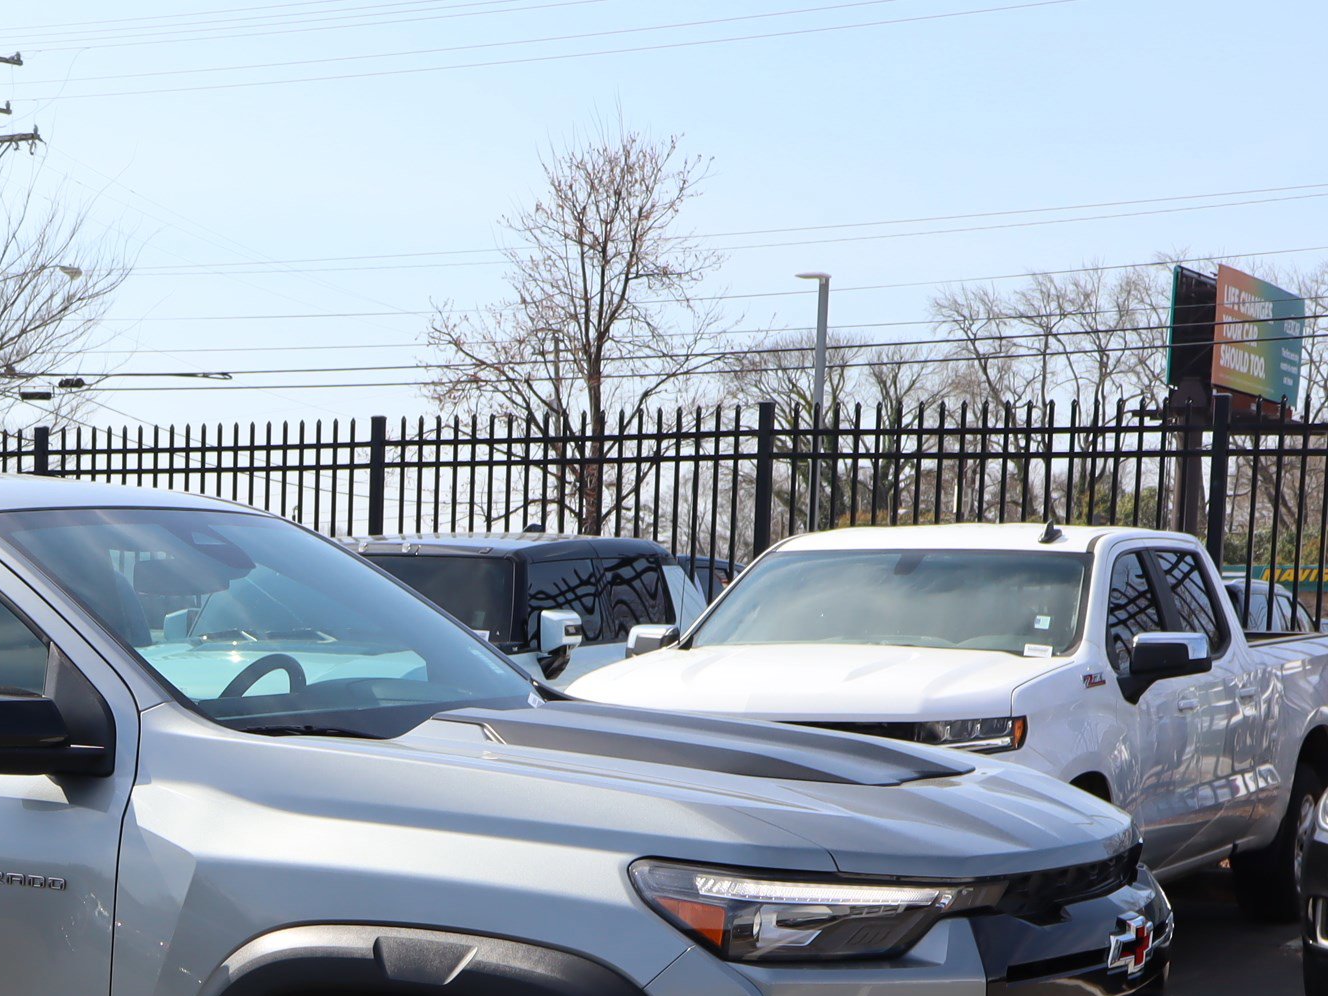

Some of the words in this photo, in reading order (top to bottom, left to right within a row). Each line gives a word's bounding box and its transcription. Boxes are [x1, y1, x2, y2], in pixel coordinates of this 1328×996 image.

[1223, 284, 1240, 311] LIFE
[1222, 314, 1242, 341] YOUR
[1243, 323, 1259, 348] CAR
[1219, 345, 1249, 373] SHOULD
[1250, 354, 1266, 379] TOO.
